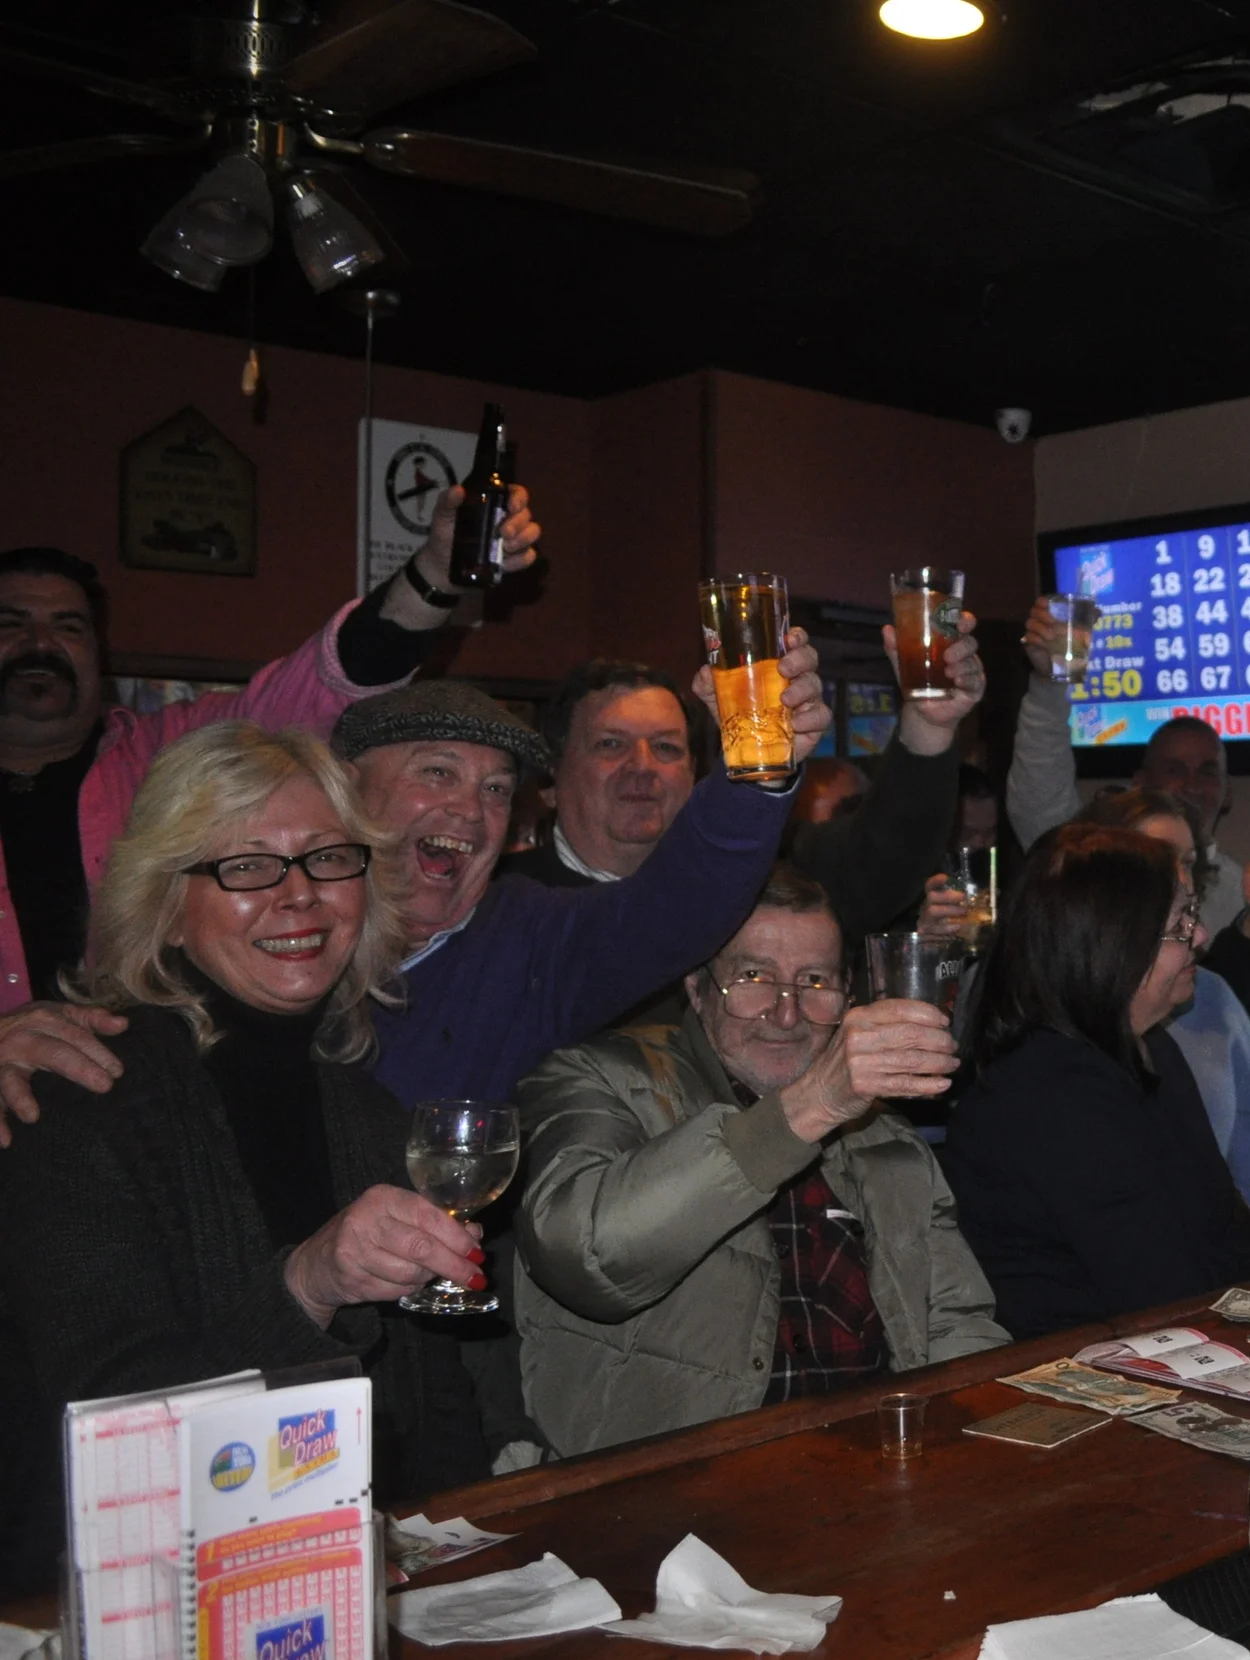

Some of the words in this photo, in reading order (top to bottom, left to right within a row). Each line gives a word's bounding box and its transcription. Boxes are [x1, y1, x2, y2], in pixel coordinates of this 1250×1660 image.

[1154, 540, 1172, 564] 1
[1197, 534, 1216, 559] 9
[1150, 571, 1182, 597] 18
[1193, 566, 1226, 593] 22
[1152, 604, 1184, 629] 38
[1195, 599, 1229, 625] 44
[1155, 636, 1186, 661] 54
[1198, 632, 1230, 658] 59
[1105, 655, 1144, 669] Draw
[1157, 668, 1188, 693] 66
[1200, 665, 1232, 690] 67
[281, 1408, 326, 1451] Quick
[294, 1428, 338, 1467] Draw
[258, 1616, 313, 1660] Quick
